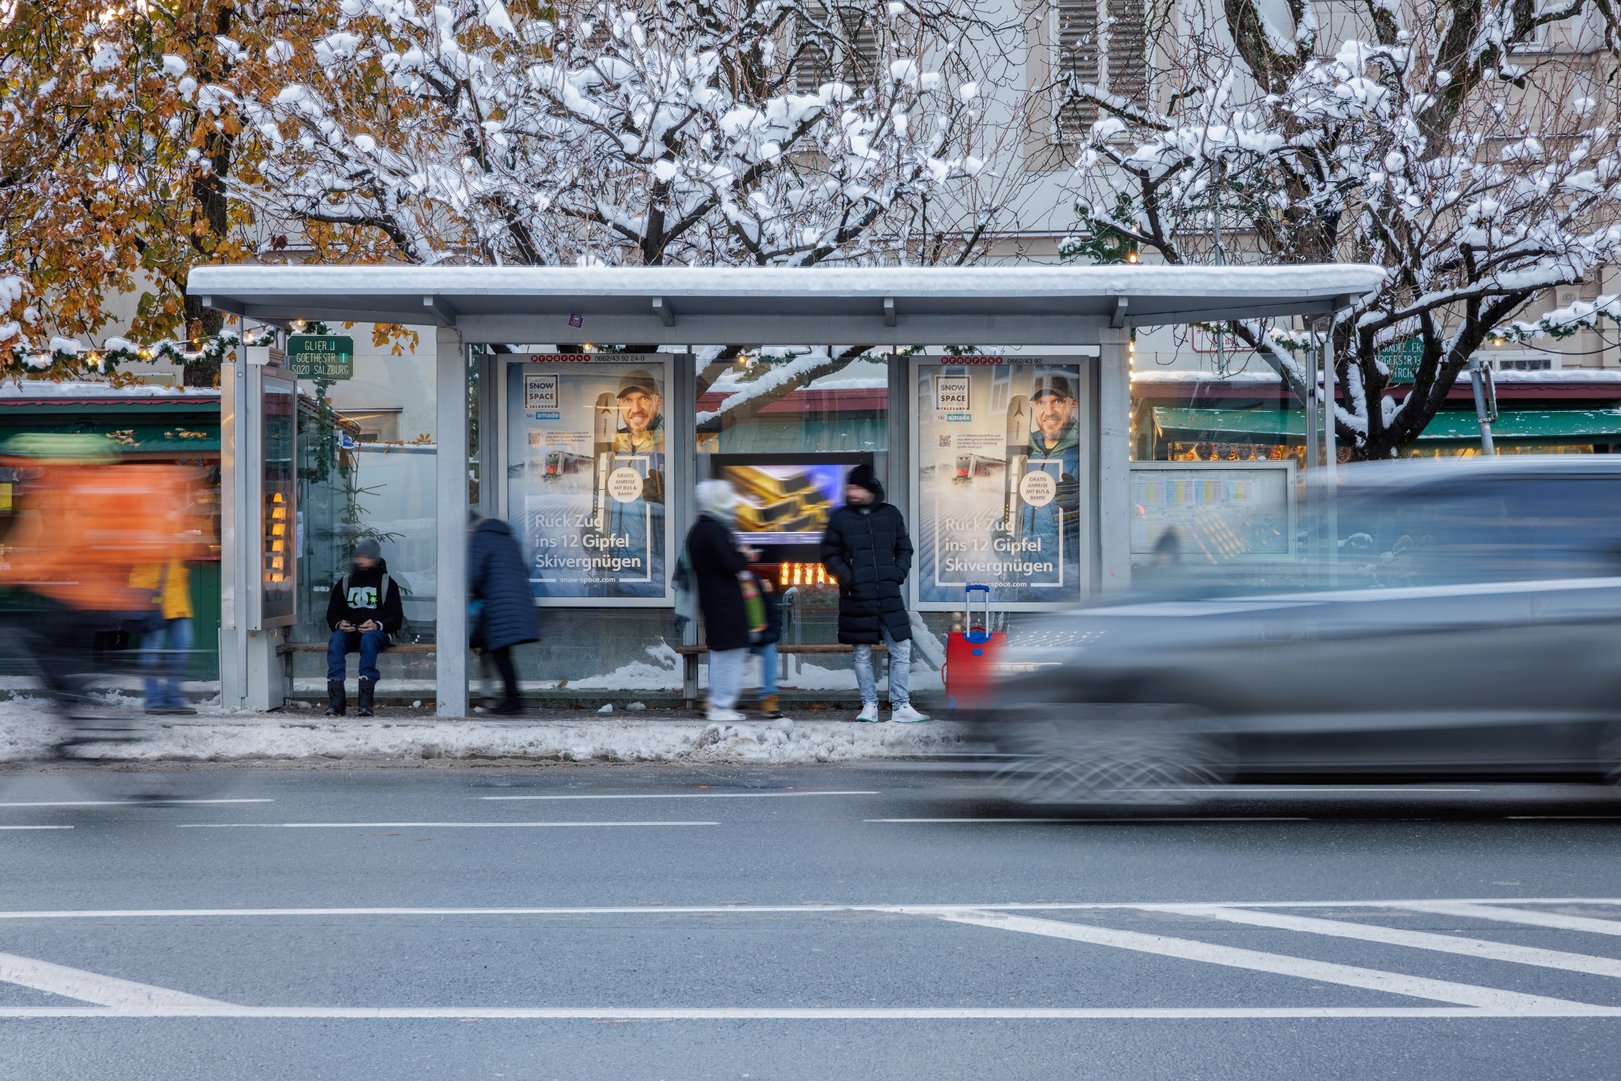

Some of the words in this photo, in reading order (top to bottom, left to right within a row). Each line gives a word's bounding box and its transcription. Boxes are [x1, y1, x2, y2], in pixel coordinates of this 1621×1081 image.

[296, 352, 337, 363] GOETHESTR.
[292, 364, 310, 375] 5020
[313, 364, 349, 375] SALZBURG
[535, 514, 571, 528] Ruck
[574, 514, 603, 532] Zug
[945, 518, 980, 532] Ruck
[984, 519, 1015, 536] Zug
[535, 535, 557, 548] ins
[562, 535, 578, 548] 12
[582, 534, 630, 551] Gipfel
[945, 539, 967, 552] ins
[973, 540, 988, 552] 12
[993, 537, 1041, 555] Gipfel
[535, 553, 641, 571] Skivergnügen
[945, 557, 1053, 576] Skivergnügen
[560, 576, 616, 584] snow-space.com
